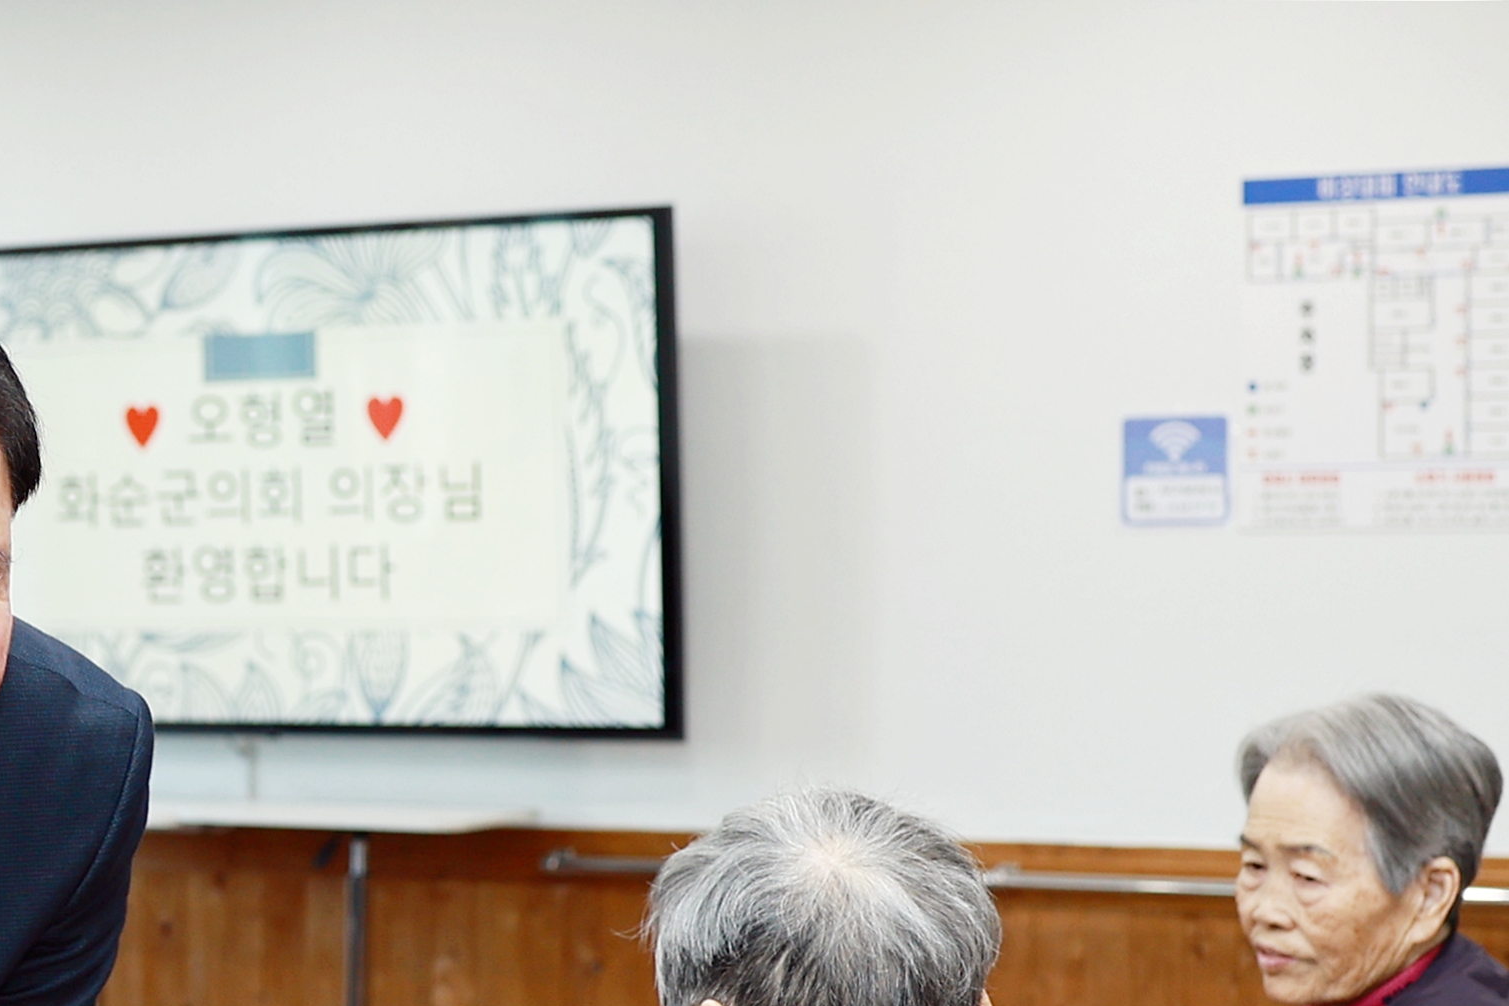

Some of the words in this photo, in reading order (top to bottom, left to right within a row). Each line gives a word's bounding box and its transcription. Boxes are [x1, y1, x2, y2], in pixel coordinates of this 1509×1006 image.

[188, 388, 335, 449] 오형열
[55, 466, 303, 527] 화순군의회
[327, 460, 481, 523] 의장님
[144, 543, 394, 603] 환영합니다
